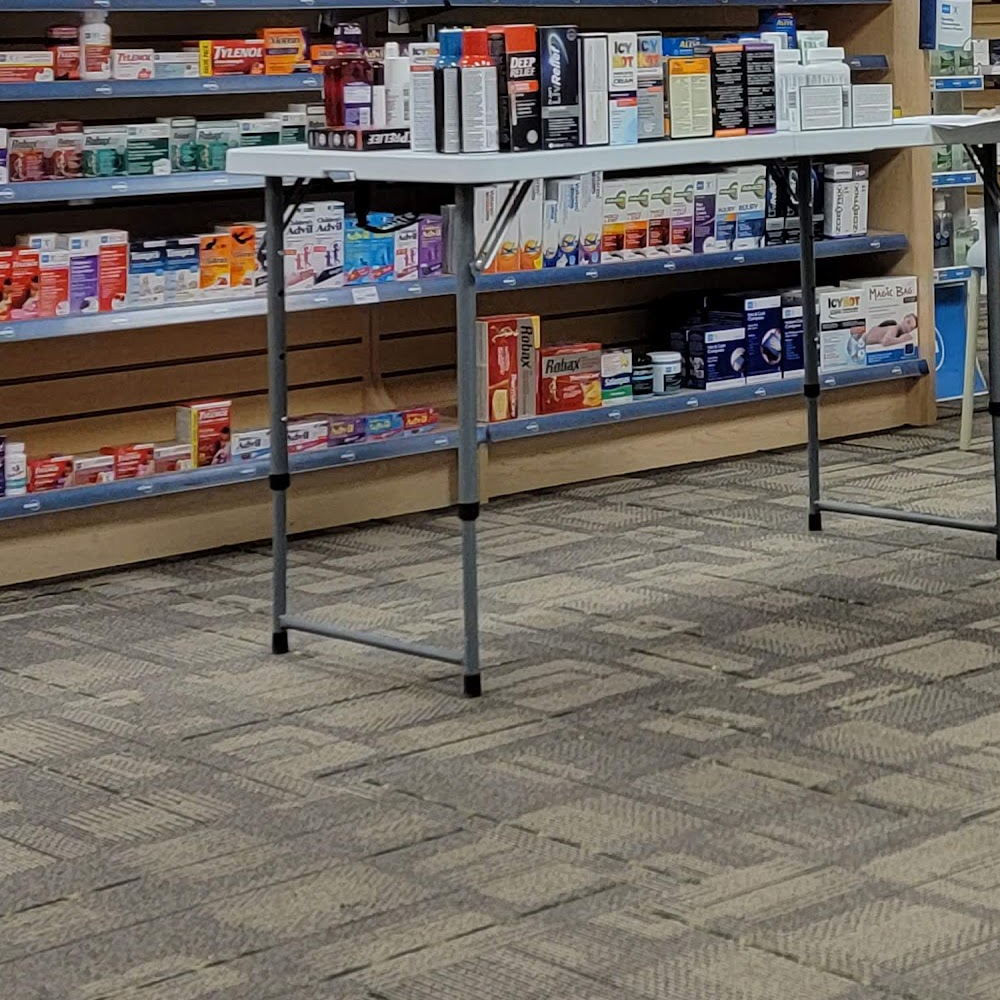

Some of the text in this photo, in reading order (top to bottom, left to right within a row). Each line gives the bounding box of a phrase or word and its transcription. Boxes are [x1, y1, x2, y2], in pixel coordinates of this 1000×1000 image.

[214, 46, 263, 60] TYLENOL
[614, 41, 632, 54] ICY
[118, 53, 151, 62] TYLENOL
[510, 56, 537, 68] DEEP
[510, 67, 537, 79] RELIEF
[316, 222, 343, 234] Advil
[896, 285, 913, 298] BAG
[828, 297, 843, 308] ICY
[520, 325, 533, 368] Robax
[545, 358, 581, 374] Robax
